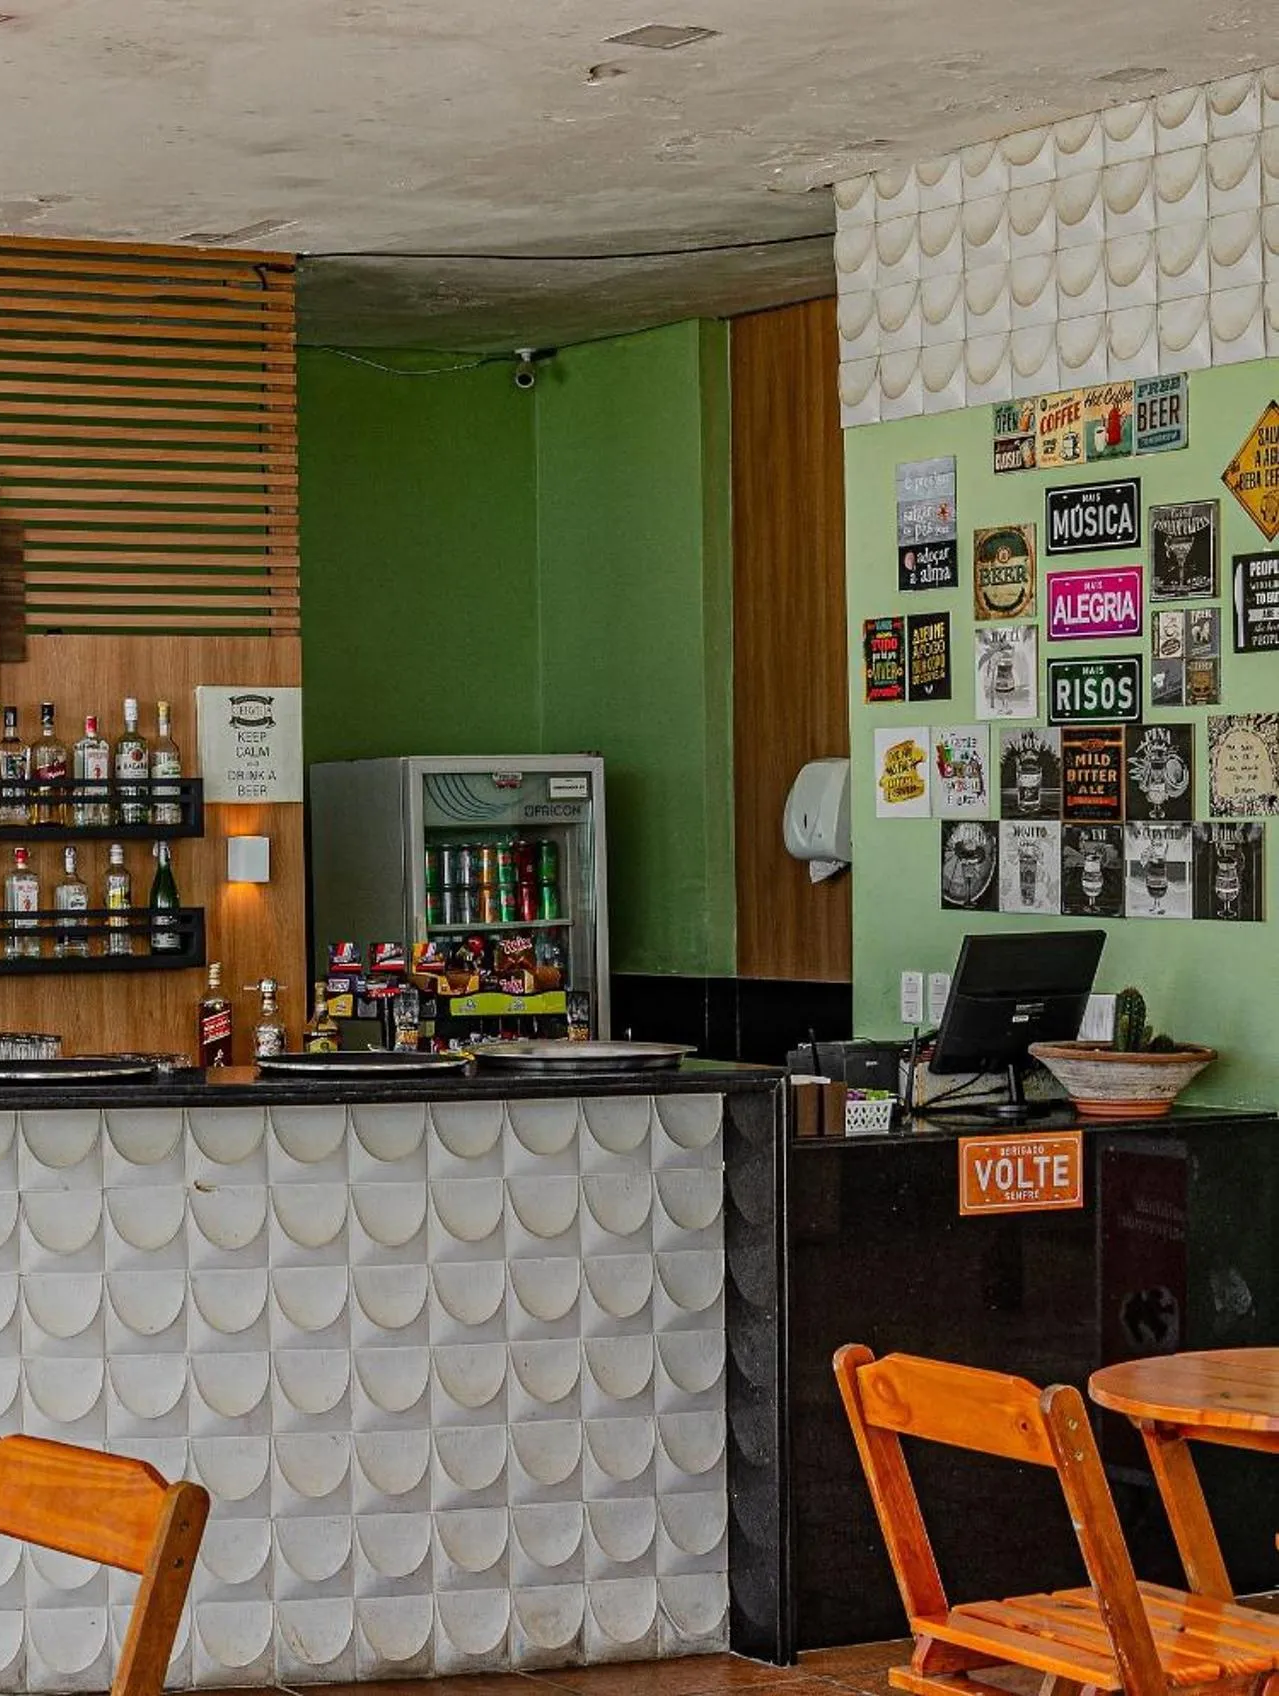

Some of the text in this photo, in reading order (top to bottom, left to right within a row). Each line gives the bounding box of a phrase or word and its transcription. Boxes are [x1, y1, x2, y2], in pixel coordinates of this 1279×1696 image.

[1138, 376, 1181, 398] FREE
[1040, 401, 1082, 436] COFFEE
[1137, 395, 1180, 432] BEER
[1053, 503, 1133, 541] MÚSICA
[920, 565, 951, 585] alma
[978, 565, 1028, 587] BEER
[1053, 591, 1136, 626] ALEGRIA
[1056, 676, 1133, 712] RISOS
[238, 731, 267, 743] KEEP
[236, 746, 270, 758] CALM
[1075, 754, 1111, 767] MILD
[228, 770, 277, 781] DRINK A
[1067, 769, 1117, 783] BITTER
[238, 784, 267, 797] BEER
[1078, 785, 1105, 795] ALE
[975, 1155, 1070, 1191] VOLTE
[1005, 1190, 1040, 1201] SEMPRE
